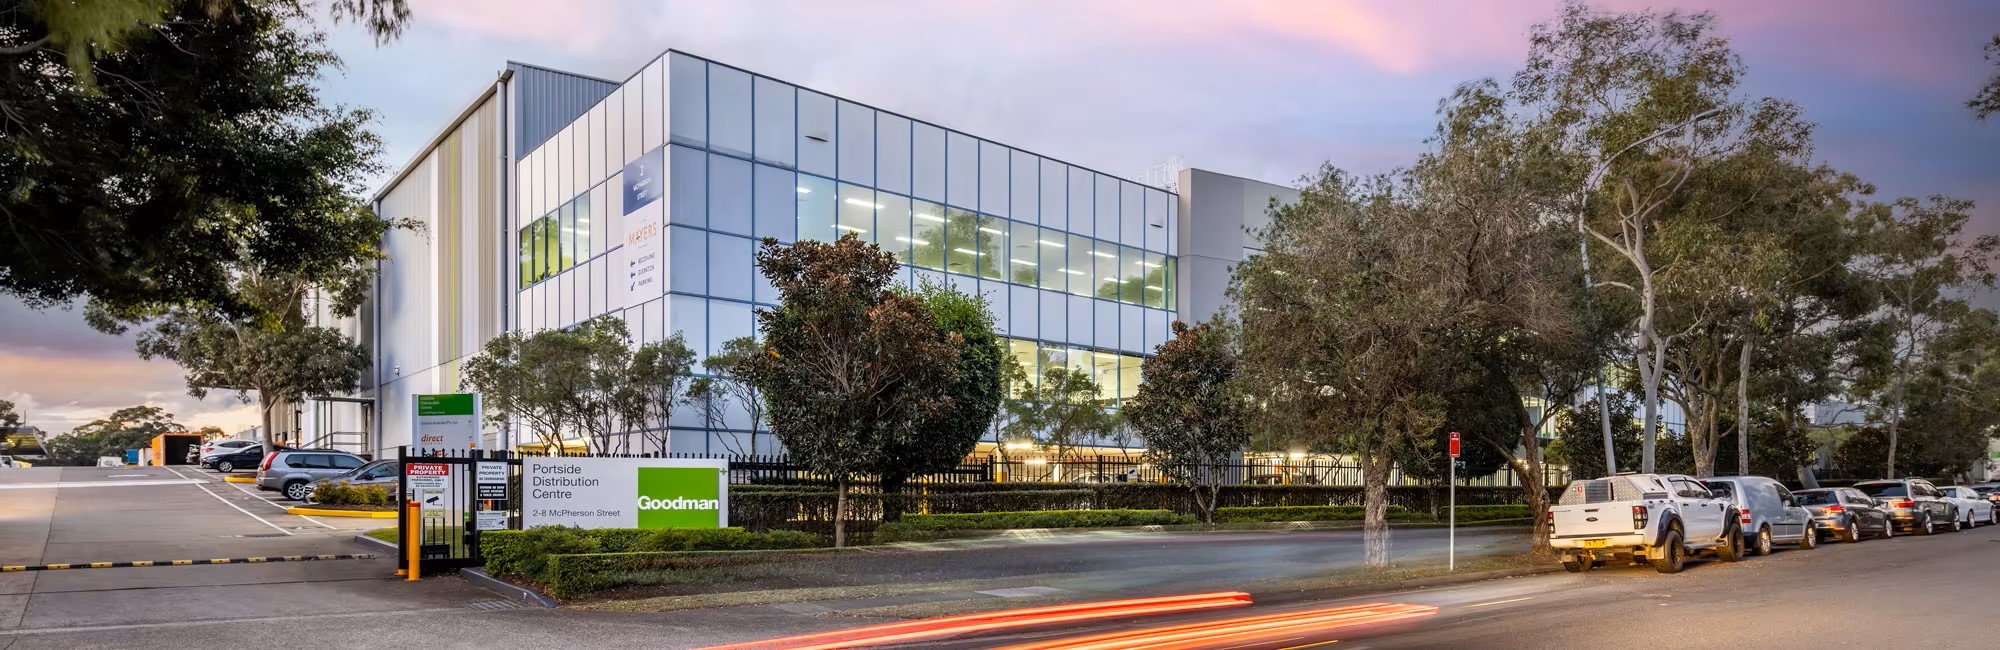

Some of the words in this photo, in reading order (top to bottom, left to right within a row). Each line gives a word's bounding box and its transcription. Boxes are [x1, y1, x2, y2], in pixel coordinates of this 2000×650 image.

[628, 221, 657, 247] MAYERS
[421, 434, 444, 442] direct
[532, 463, 581, 474] Portside
[532, 476, 599, 487] Distribution
[532, 489, 572, 499] Centre
[638, 495, 719, 510] Goodman
[532, 509, 547, 517] 2-8
[549, 509, 595, 517] McPherson
[596, 509, 620, 517] Street
